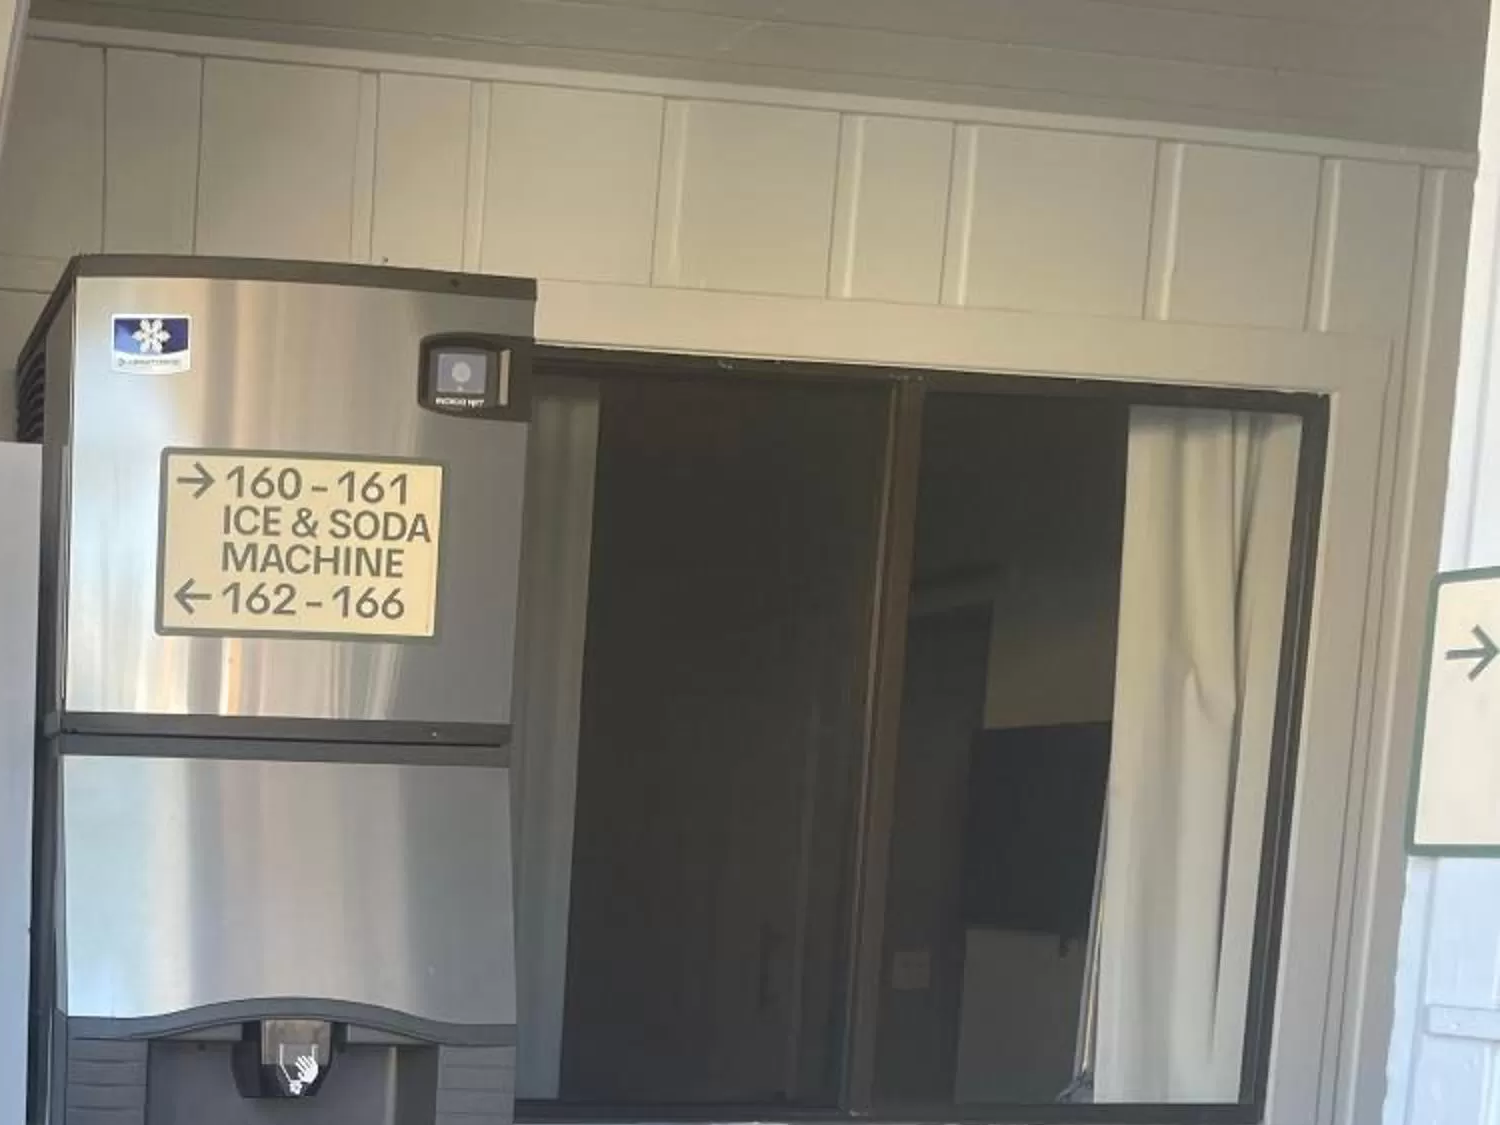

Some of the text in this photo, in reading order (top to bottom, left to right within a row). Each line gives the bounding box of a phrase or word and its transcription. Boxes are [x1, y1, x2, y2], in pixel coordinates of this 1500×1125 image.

[223, 505, 431, 543] ICE & SODA
[221, 541, 405, 578] MACHINE
